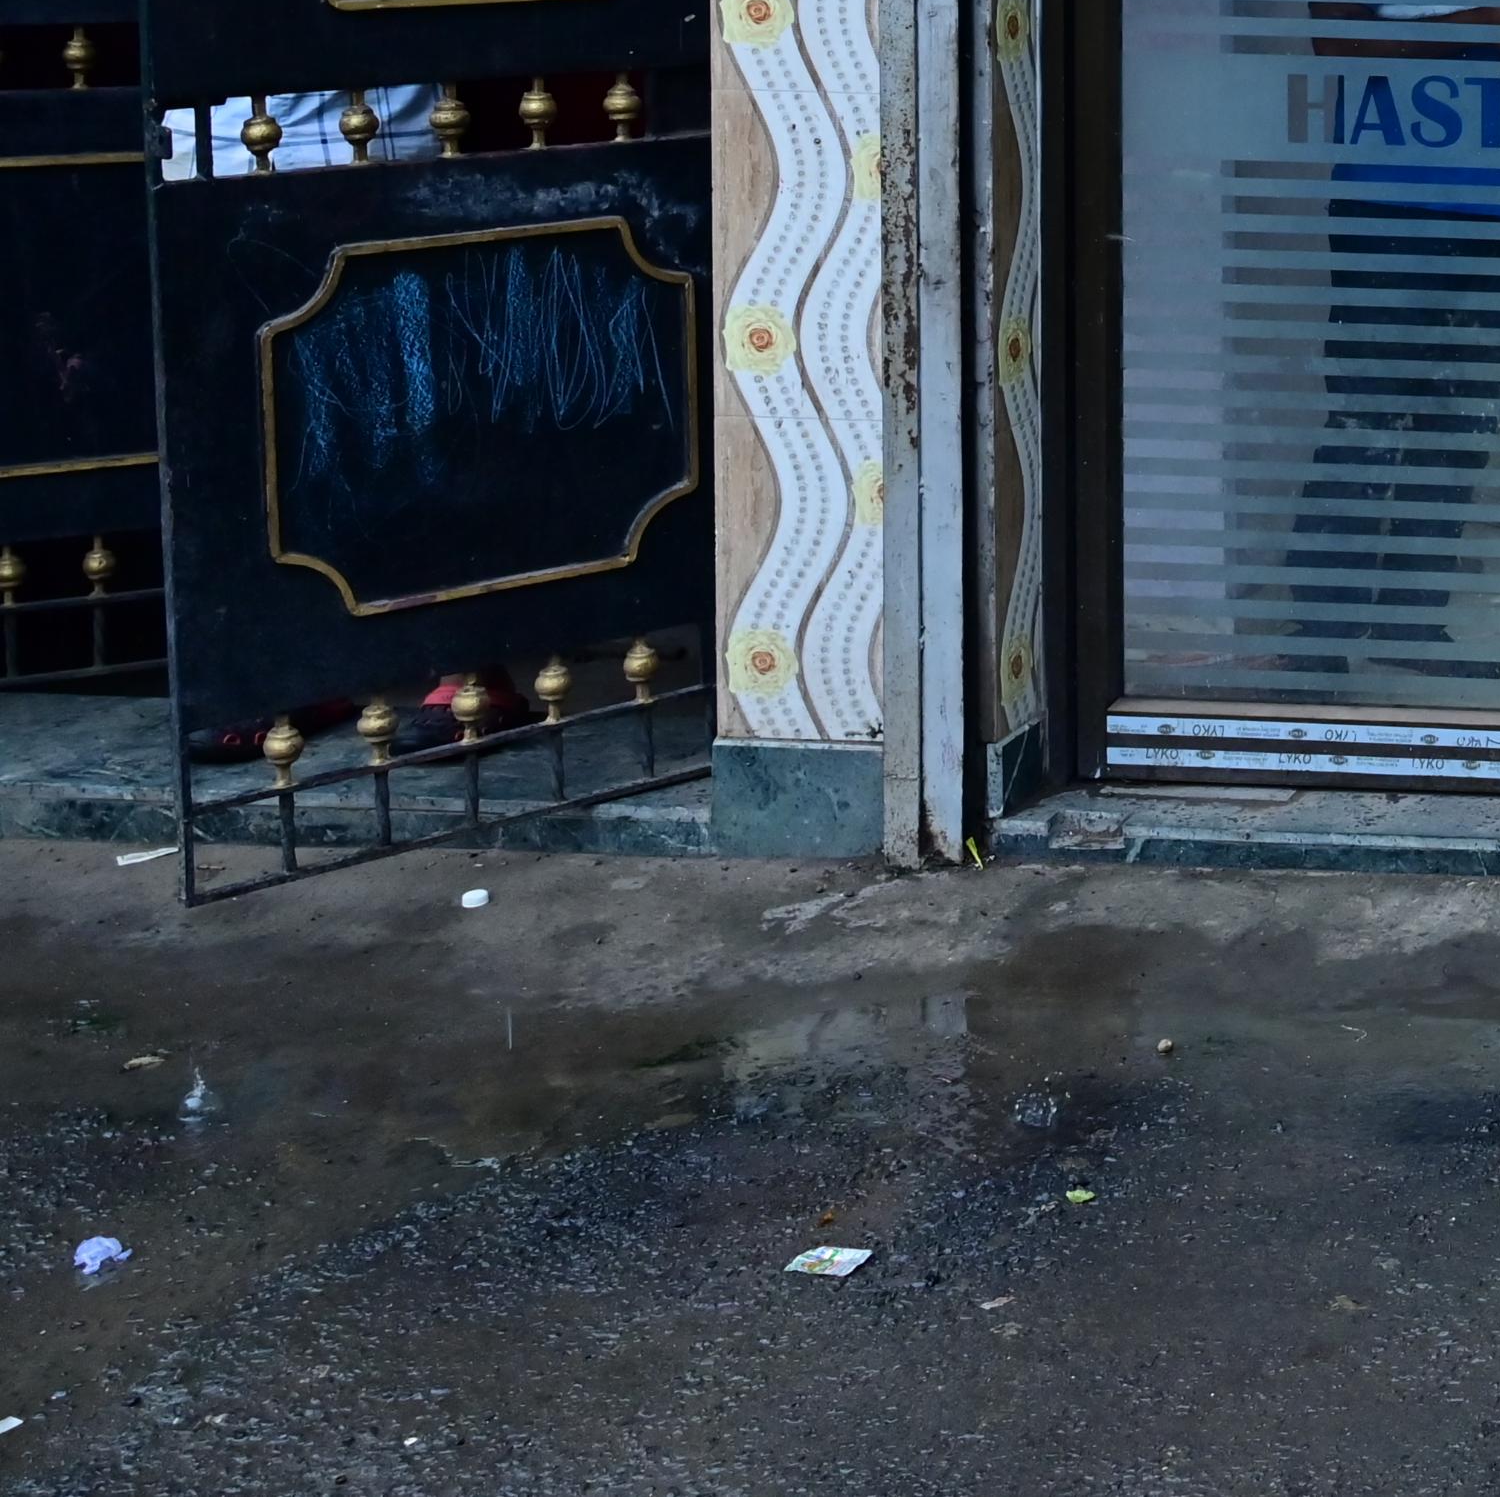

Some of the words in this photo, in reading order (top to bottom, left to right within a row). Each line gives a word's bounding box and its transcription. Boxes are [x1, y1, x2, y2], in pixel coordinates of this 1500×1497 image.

[1192, 724, 1225, 736] LYKO
[1145, 748, 1179, 760] LYKO
[1278, 753, 1312, 765] LYKO
